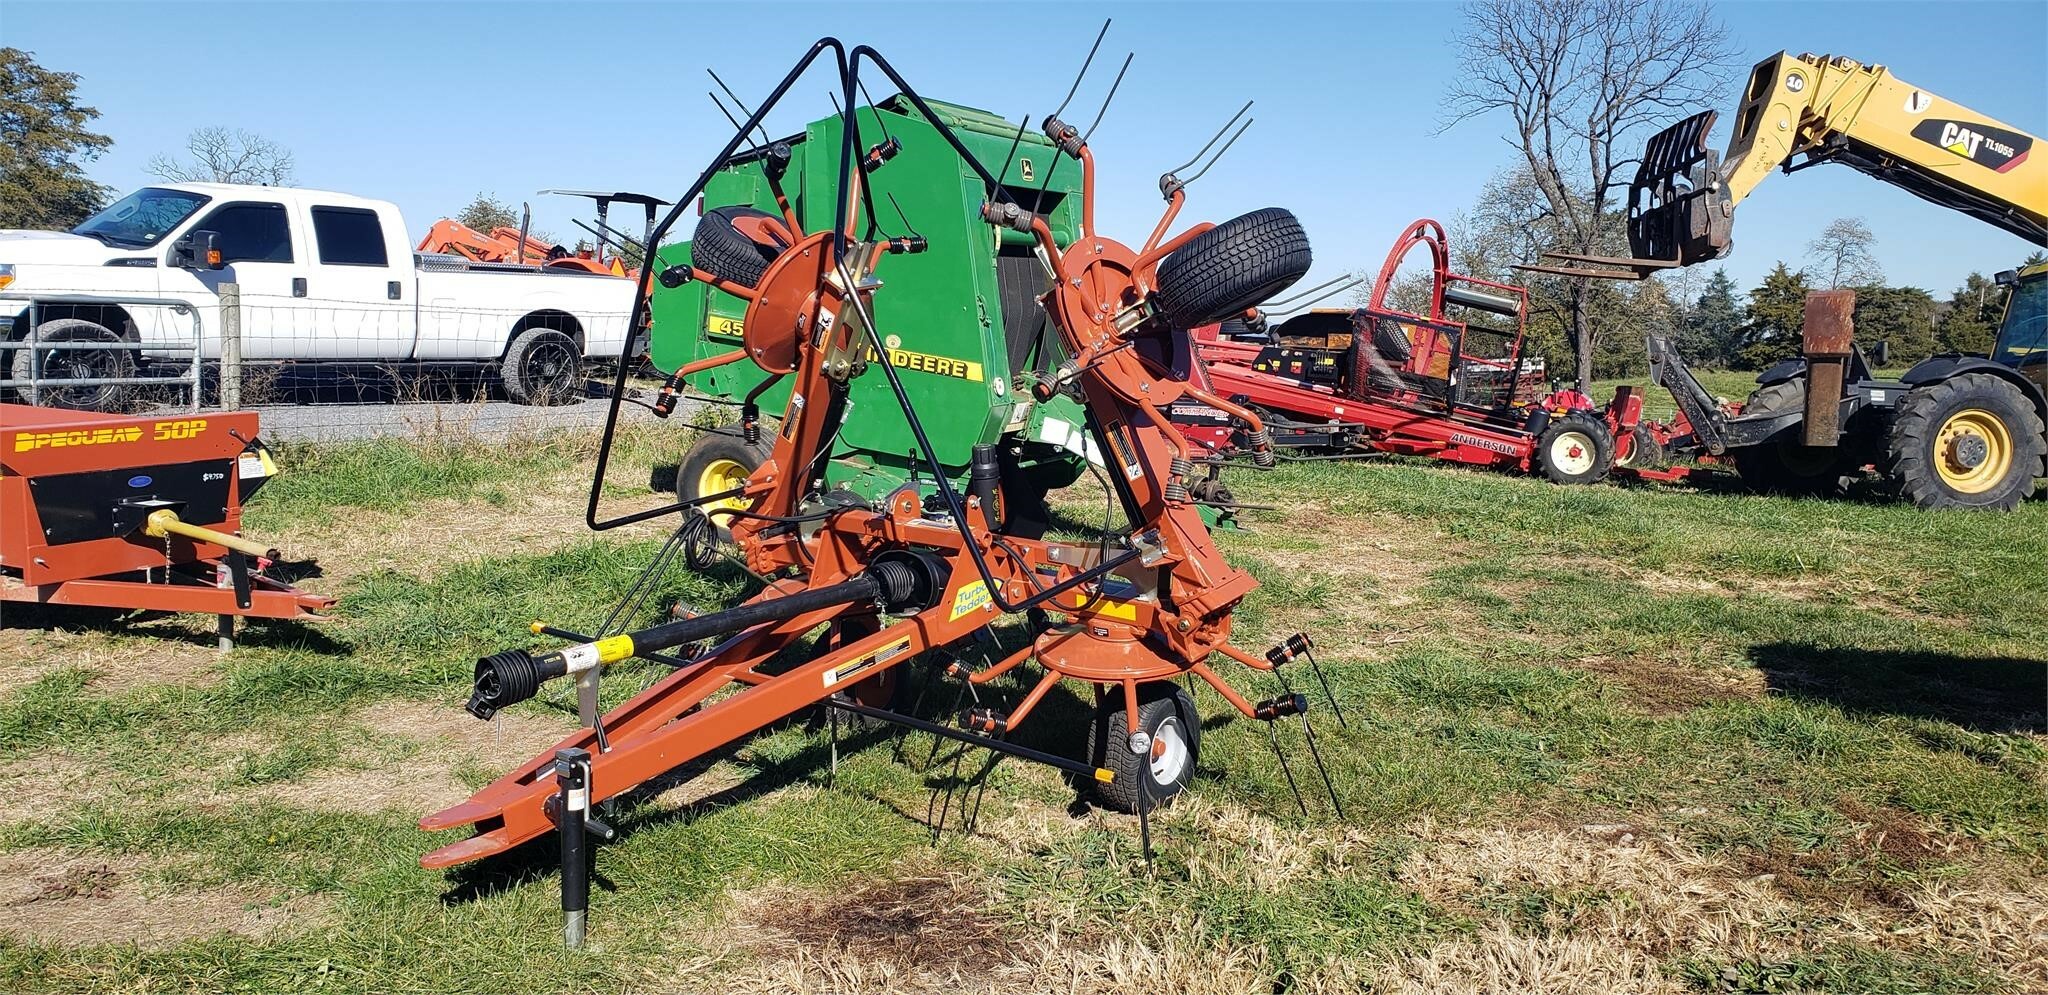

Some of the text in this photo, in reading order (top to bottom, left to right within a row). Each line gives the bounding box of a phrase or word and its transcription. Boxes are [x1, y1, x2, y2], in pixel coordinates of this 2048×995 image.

[1786, 76, 1803, 90] 10
[1940, 122, 2015, 159] CAT TL1055
[719, 319, 744, 338] 45
[894, 350, 968, 379] DEERE
[35, 420, 207, 449] PEQUEA 50P
[1450, 432, 1518, 457] ANDERSON
